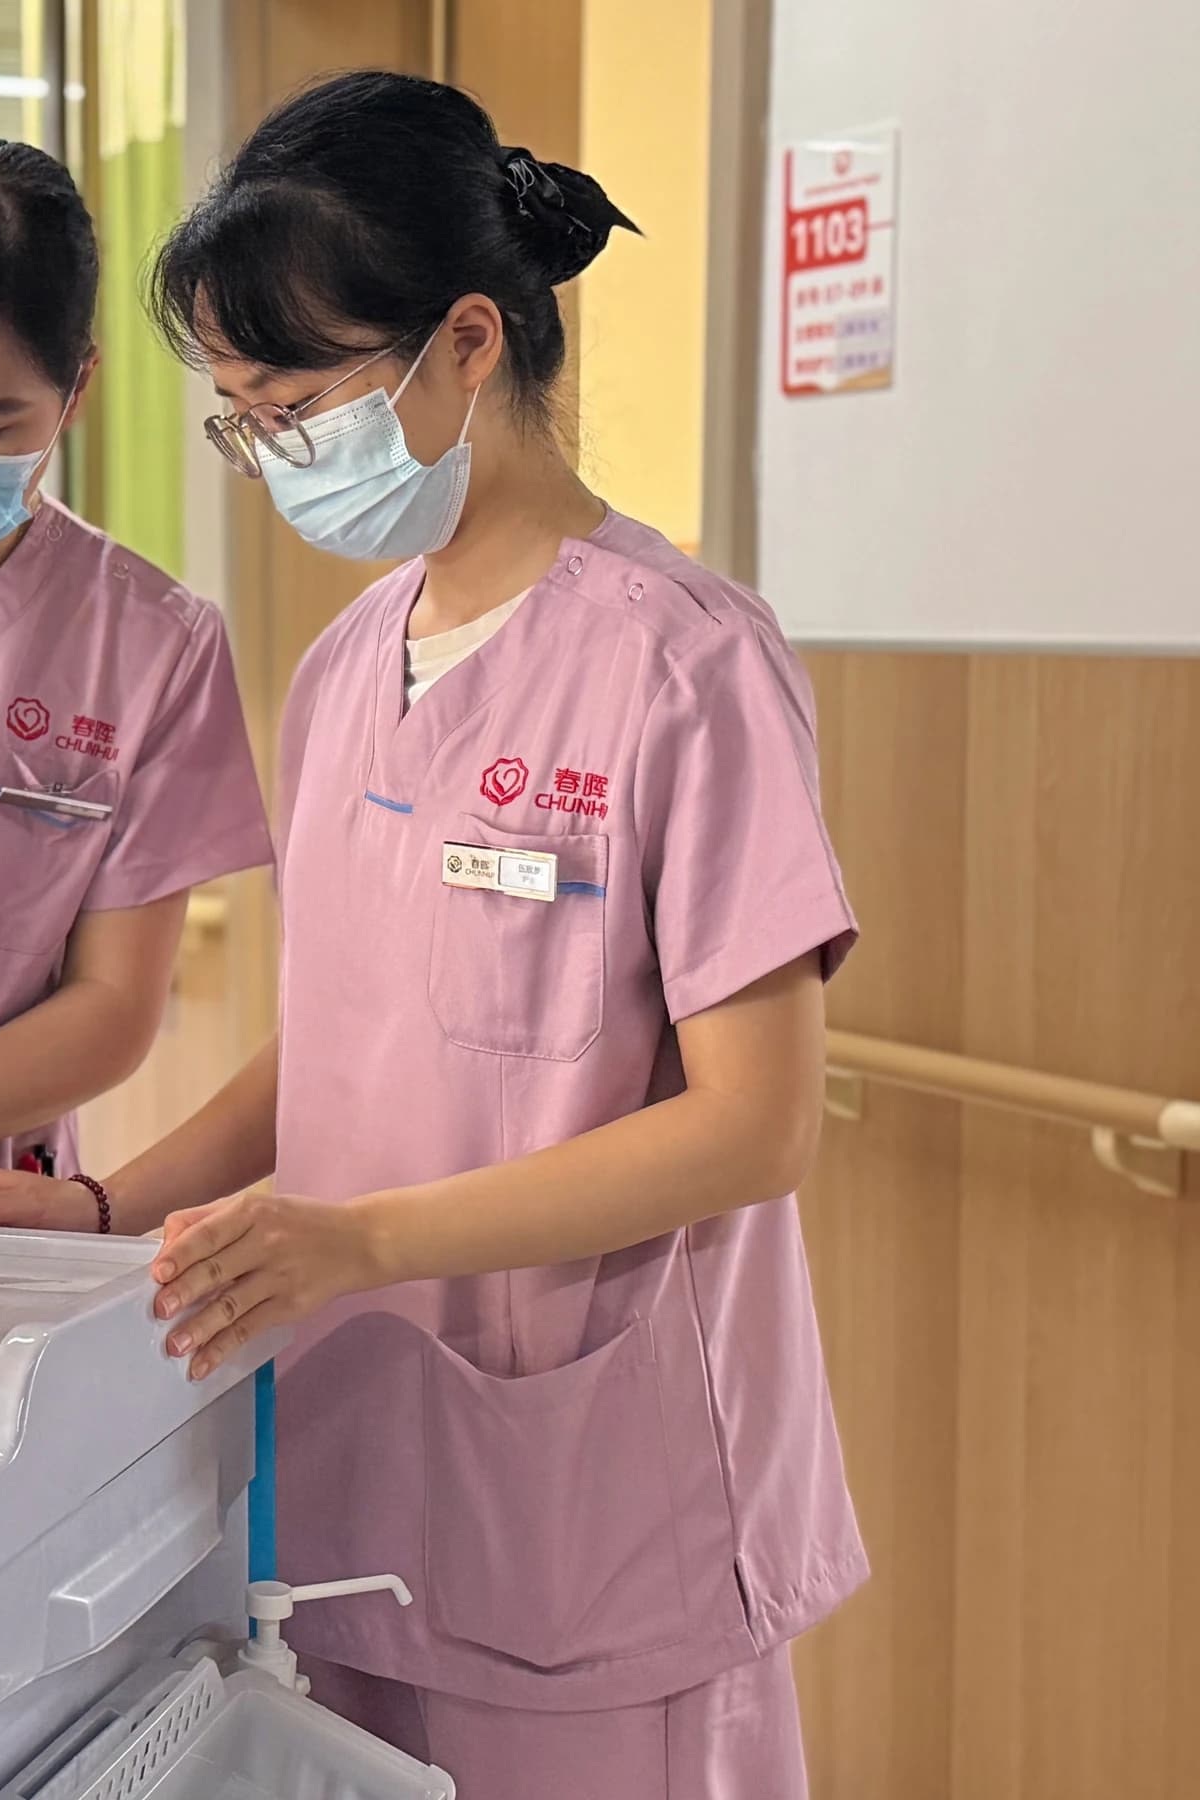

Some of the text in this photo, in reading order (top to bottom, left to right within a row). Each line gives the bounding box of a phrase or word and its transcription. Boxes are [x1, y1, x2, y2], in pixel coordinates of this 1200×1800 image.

[791, 207, 864, 263] 1103
[71, 714, 116, 744] 春晖
[55, 735, 120, 761] CHUNHUI
[554, 768, 608, 799] 春晖
[534, 793, 609, 820] CHUNH
